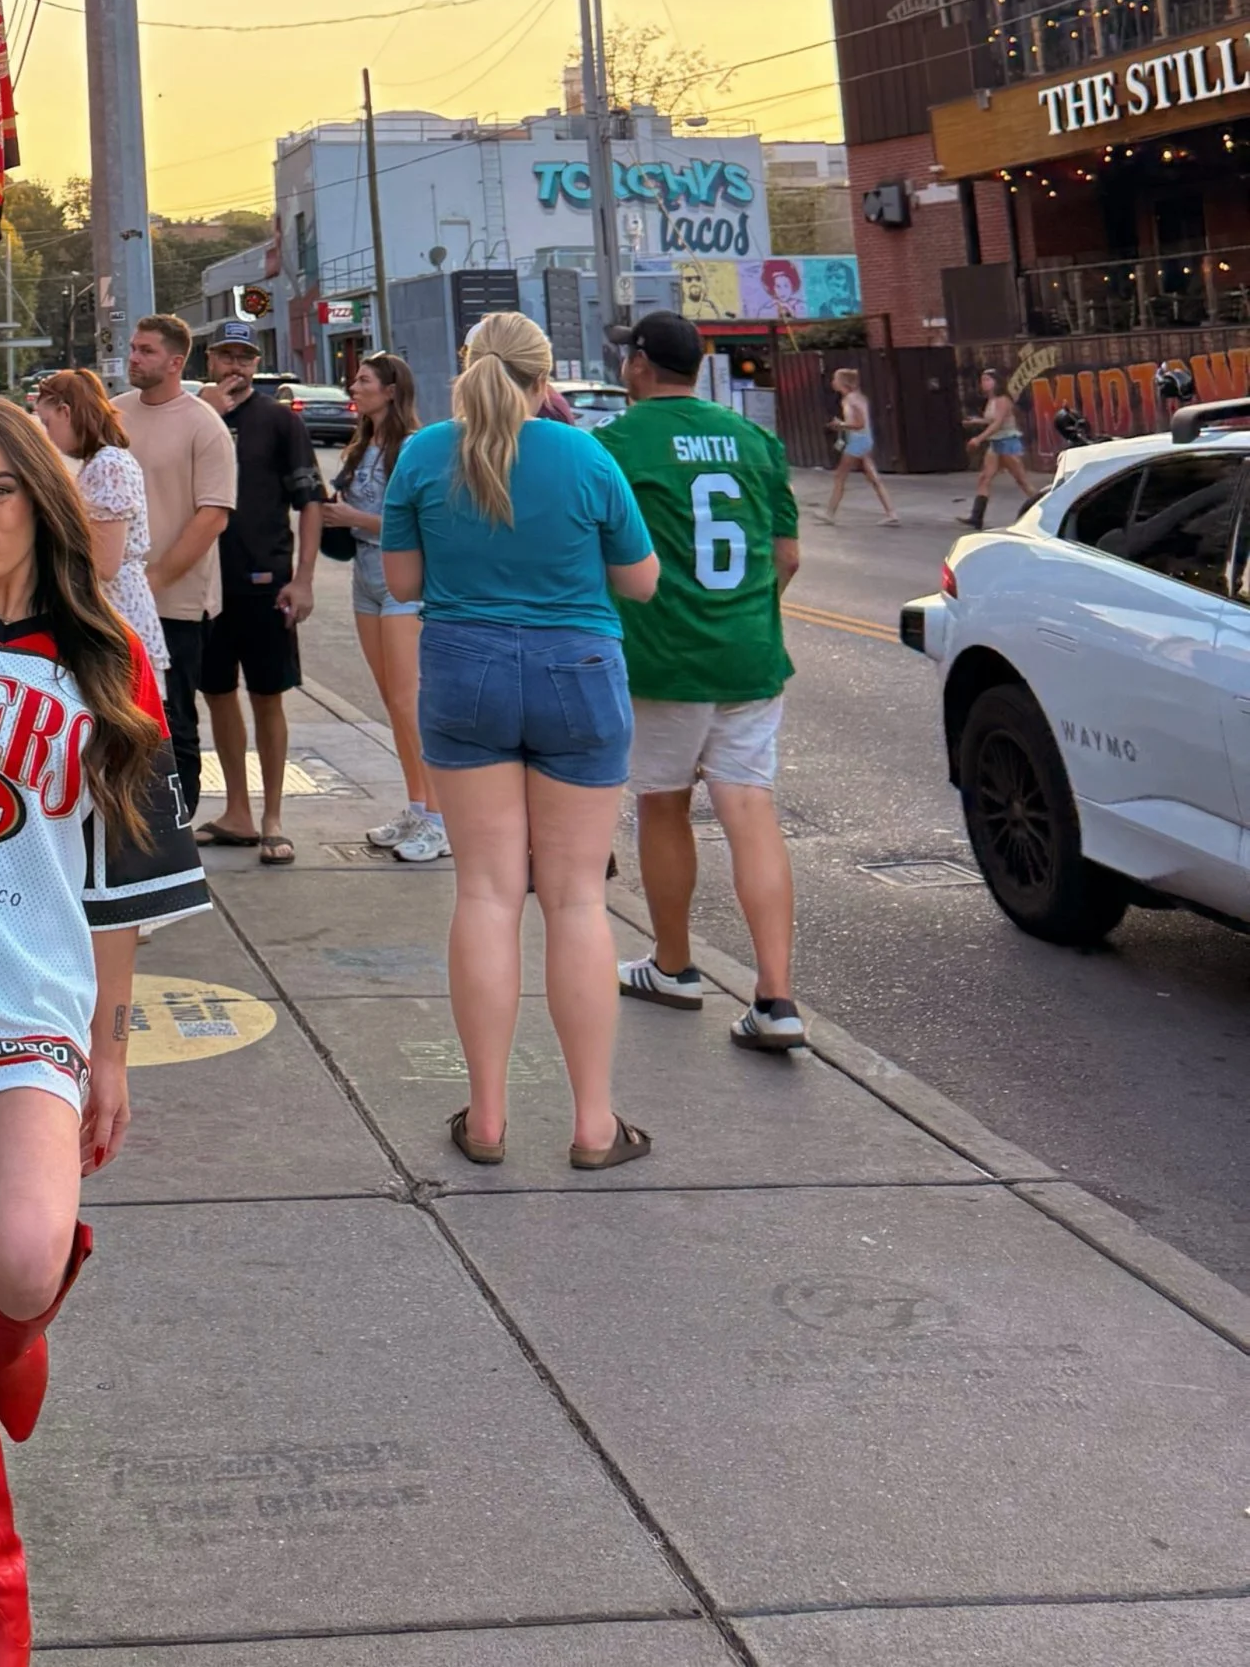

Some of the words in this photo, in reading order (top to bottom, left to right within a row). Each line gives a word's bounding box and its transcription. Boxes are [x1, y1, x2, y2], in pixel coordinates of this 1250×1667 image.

[1038, 71, 1120, 135] THE
[1125, 34, 1250, 116] STILL
[673, 435, 739, 462] SMITH
[1032, 348, 1250, 456] MIDTW
[690, 472, 747, 590] 6
[1060, 720, 1136, 762] WAYMO
